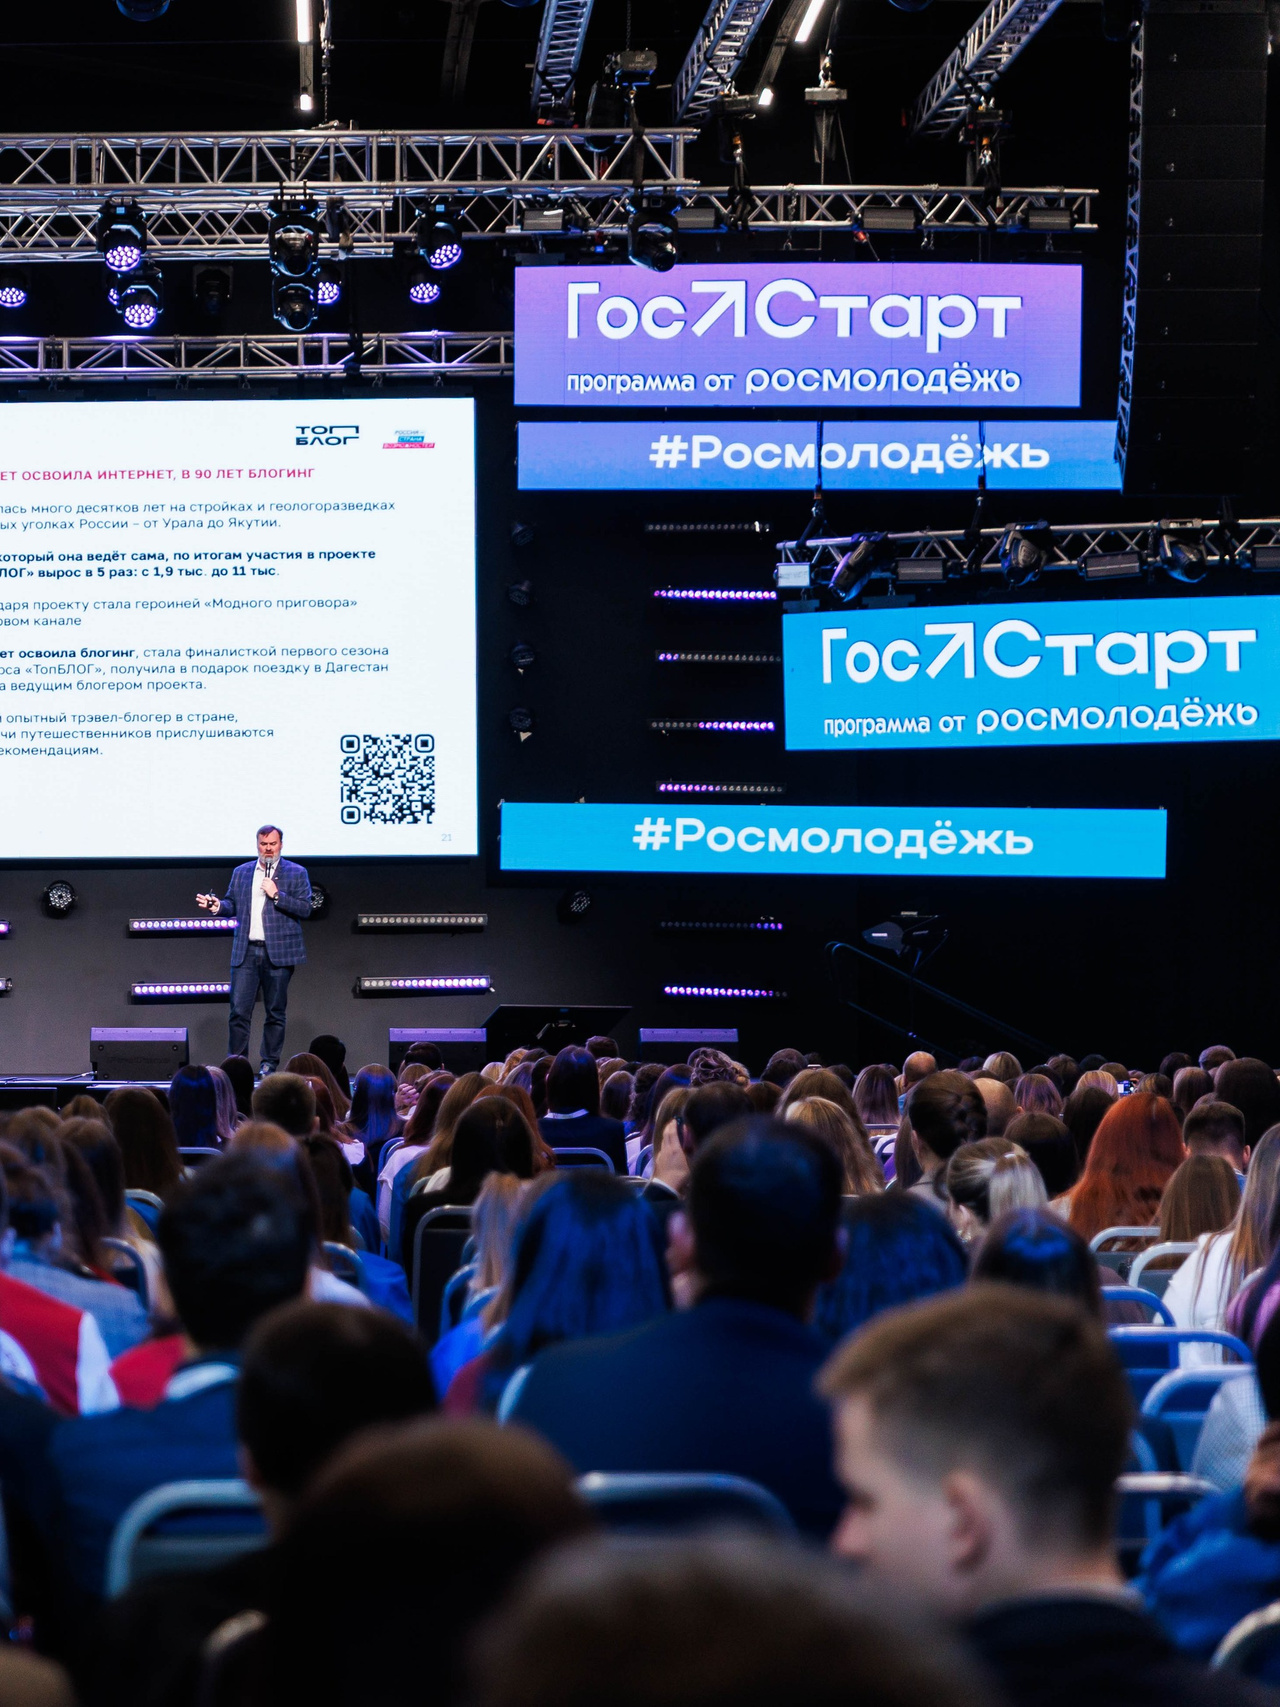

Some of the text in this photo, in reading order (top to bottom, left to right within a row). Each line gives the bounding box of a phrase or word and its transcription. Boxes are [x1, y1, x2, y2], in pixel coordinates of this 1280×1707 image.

[567, 361, 1020, 395] программа от росмолодёжь
[295, 424, 360, 435] ТОП
[295, 435, 360, 447] БЛОГ
[649, 433, 1050, 474] #Росмолодёжь
[21, 470, 93, 481] ОСВОИЛА
[181, 469, 191, 480] В
[194, 469, 212, 479] 90
[215, 468, 244, 479] ЛЕТ
[248, 468, 315, 479] БЛОГИНГ
[31, 504, 73, 514] много
[75, 503, 139, 515] десятков
[142, 503, 167, 513] лет
[169, 503, 186, 513] на
[189, 501, 253, 515] стройках
[257, 503, 266, 512] и
[269, 501, 396, 514] геологоразведках
[21, 520, 75, 533] уголках
[79, 518, 129, 530] России
[143, 519, 159, 529] от
[161, 517, 204, 531] Урала
[206, 519, 225, 530] до
[57, 553, 84, 563] она
[86, 549, 127, 563] ведёт
[173, 551, 191, 561] по
[193, 551, 243, 561] итогам
[245, 551, 303, 563] участия
[306, 551, 315, 560] в
[318, 550, 377, 563] проекте
[37, 568, 82, 581] вырос
[84, 568, 94, 578] в
[96, 566, 106, 578] 5
[141, 567, 150, 577] с
[153, 565, 175, 579] 1,9
[210, 567, 229, 579] до
[231, 565, 247, 577] 11
[33, 601, 90, 613] проекту
[93, 600, 132, 610] стала
[135, 597, 201, 612] героиней
[33, 617, 82, 627] канале
[17, 649, 77, 659] освоила
[143, 648, 181, 658] стала
[185, 645, 277, 660] финалисткой
[281, 647, 338, 659] первого
[340, 647, 389, 657] сезона
[110, 665, 176, 677] получила
[179, 665, 188, 674] в
[191, 664, 249, 677] подарок
[253, 663, 311, 676] поездку
[313, 663, 322, 673] в
[324, 661, 389, 675] Дагестан
[10, 681, 73, 694] ведущим
[75, 679, 143, 693] блогером
[5, 711, 67, 724] опытный
[70, 711, 172, 726] трэвел-блогер
[175, 713, 184, 723] в
[824, 697, 1258, 738] программа от росмолодёжь
[20, 729, 153, 743] путешественников
[155, 728, 275, 741] прислушиваются
[632, 817, 1034, 859] #Росмолодёжь
